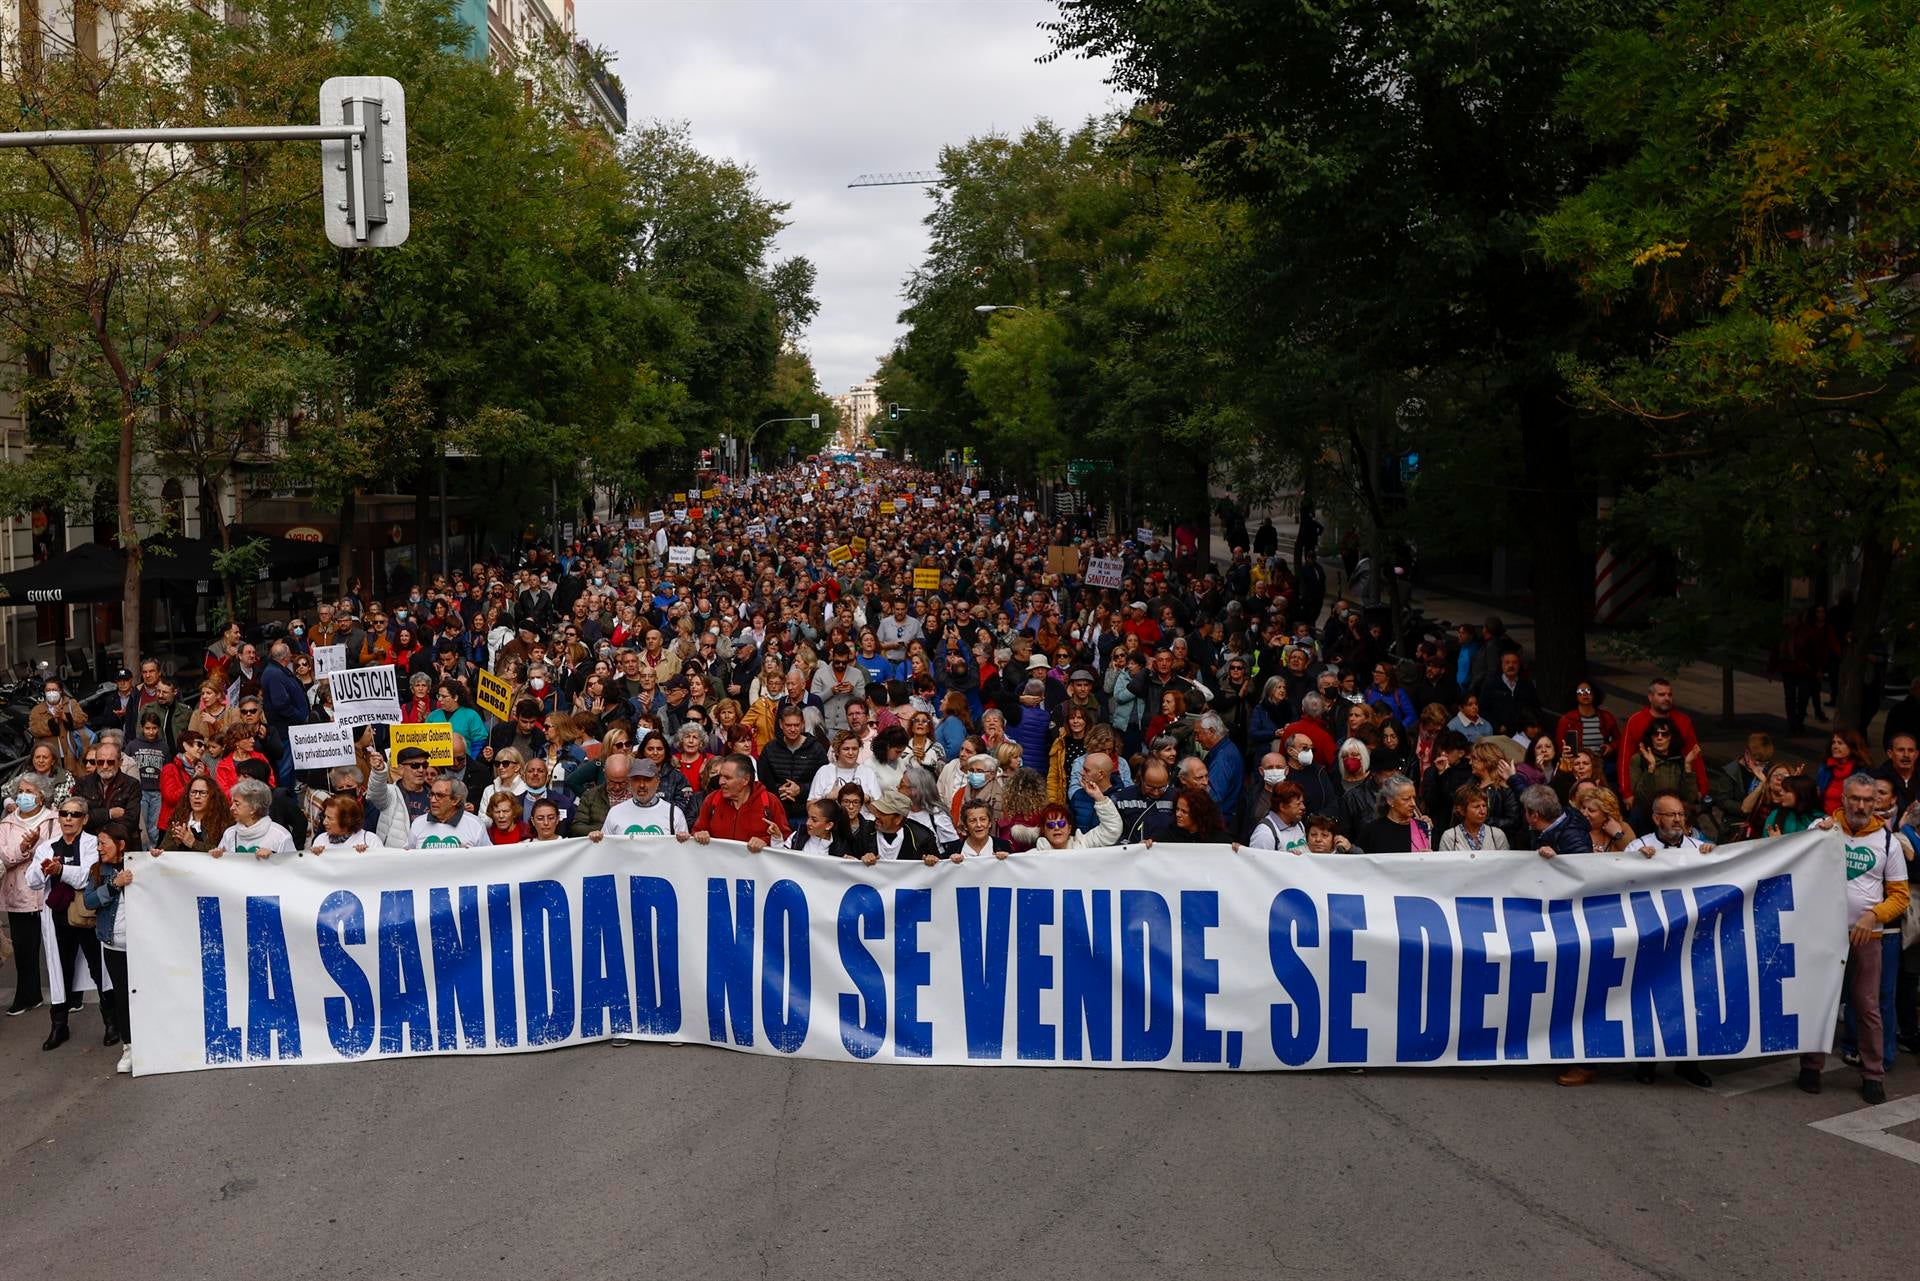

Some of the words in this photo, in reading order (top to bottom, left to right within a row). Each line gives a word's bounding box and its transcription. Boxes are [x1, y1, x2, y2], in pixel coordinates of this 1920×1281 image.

[854, 505, 867, 516] NO
[288, 534, 320, 544] VALOR
[1087, 573, 1121, 587] SANITARIOS
[27, 588, 62, 602] GOIKO
[332, 671, 396, 701] ¡JUSTICIA!
[481, 676, 508, 700] AYUSO.
[479, 690, 507, 714] ABUSO.
[338, 714, 375, 729] ¡RECORTES
[375, 713, 399, 722] MATAN!
[294, 733, 317, 745] Sanidad
[318, 731, 341, 743] Pública,
[396, 731, 405, 743] Con
[406, 730, 427, 745] cualquier
[294, 749, 304, 762] Ley
[305, 746, 343, 762] privatizadora,
[197, 895, 302, 1064] LA
[316, 874, 682, 1056] SANIDAD
[706, 877, 812, 1052] NO
[836, 883, 934, 1060] SE
[956, 886, 1245, 1069] VENDE,
[1269, 887, 1369, 1067] SE
[1394, 874, 1799, 1063] DEFIENDE
